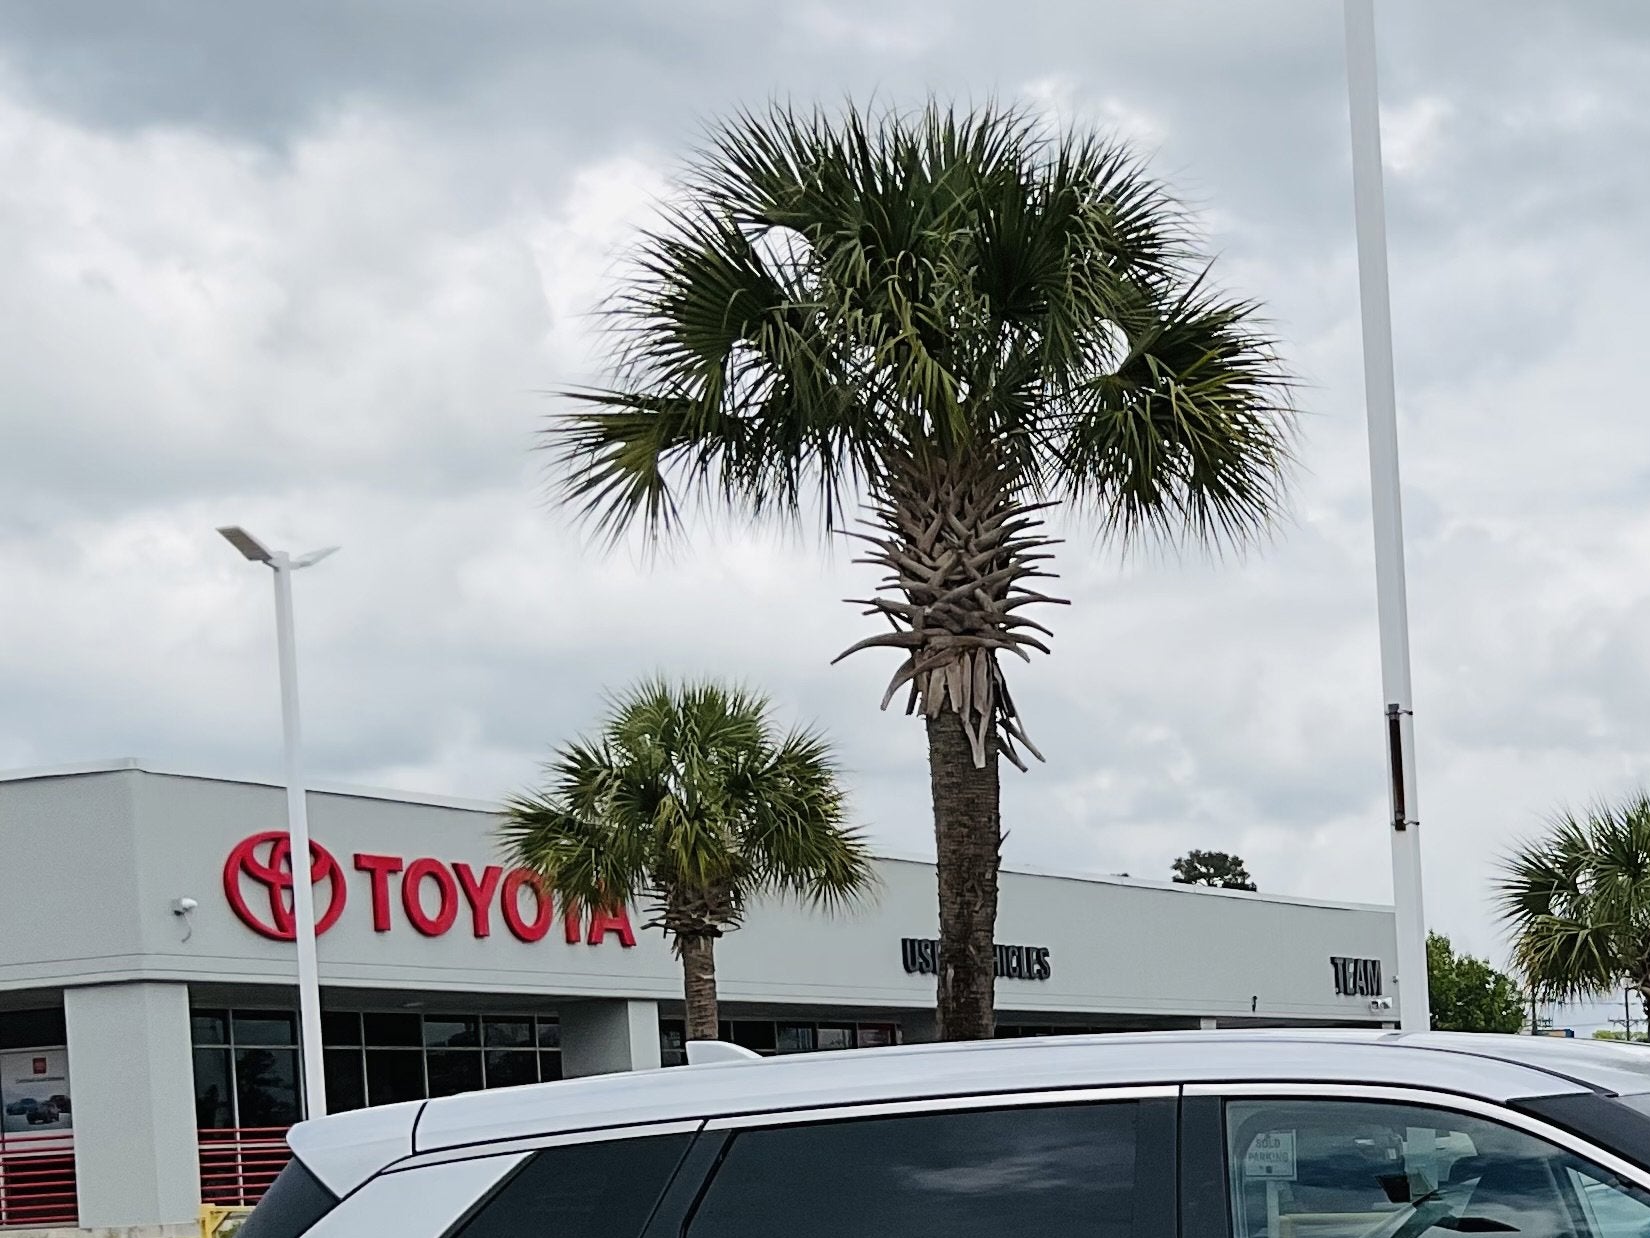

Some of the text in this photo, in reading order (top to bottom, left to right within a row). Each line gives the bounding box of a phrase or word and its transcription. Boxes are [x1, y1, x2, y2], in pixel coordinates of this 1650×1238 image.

[1329, 956, 1383, 997] TEAM
[1255, 1138, 1281, 1149] SOLD
[1247, 1151, 1290, 1163] PARKING
